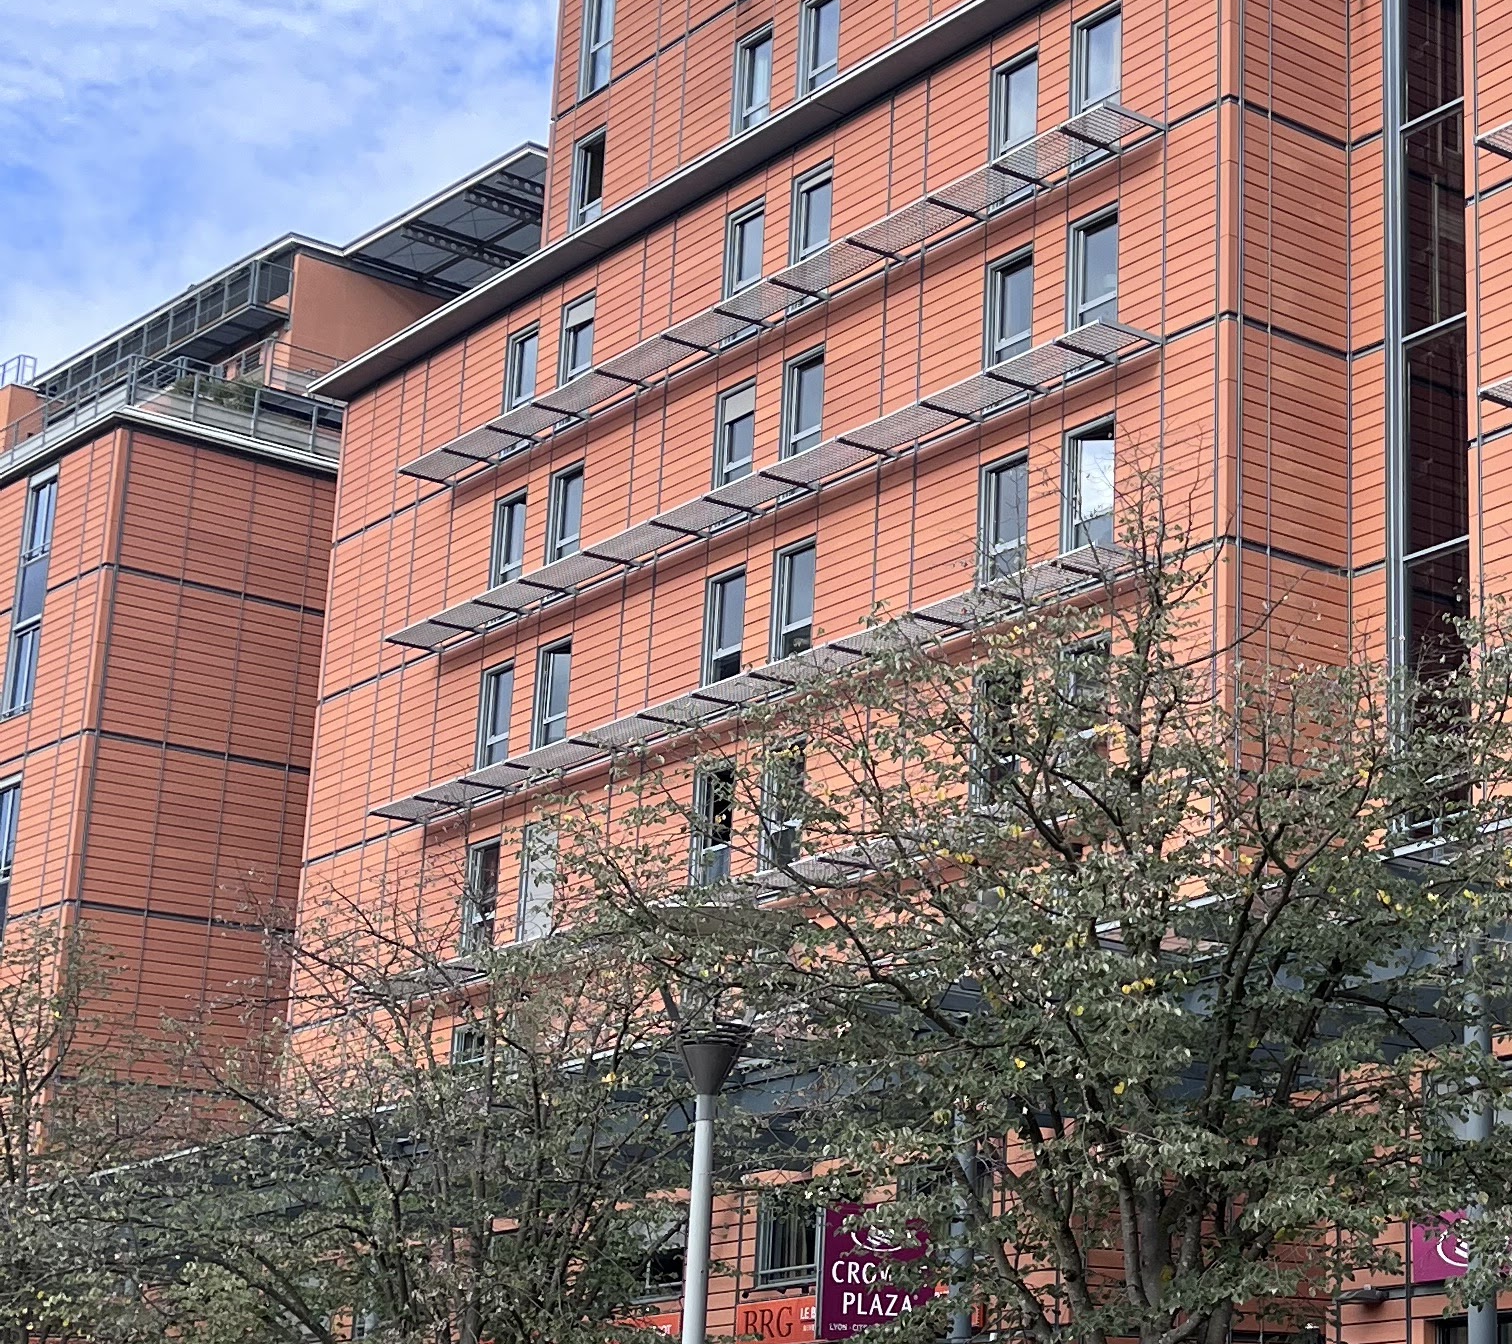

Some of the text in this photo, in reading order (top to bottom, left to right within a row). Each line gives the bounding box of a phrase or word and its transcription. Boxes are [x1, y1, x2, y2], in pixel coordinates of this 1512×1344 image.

[832, 1260, 928, 1287] CRO
[842, 1291, 913, 1317] PLAZA
[743, 1306, 793, 1338] BRG
